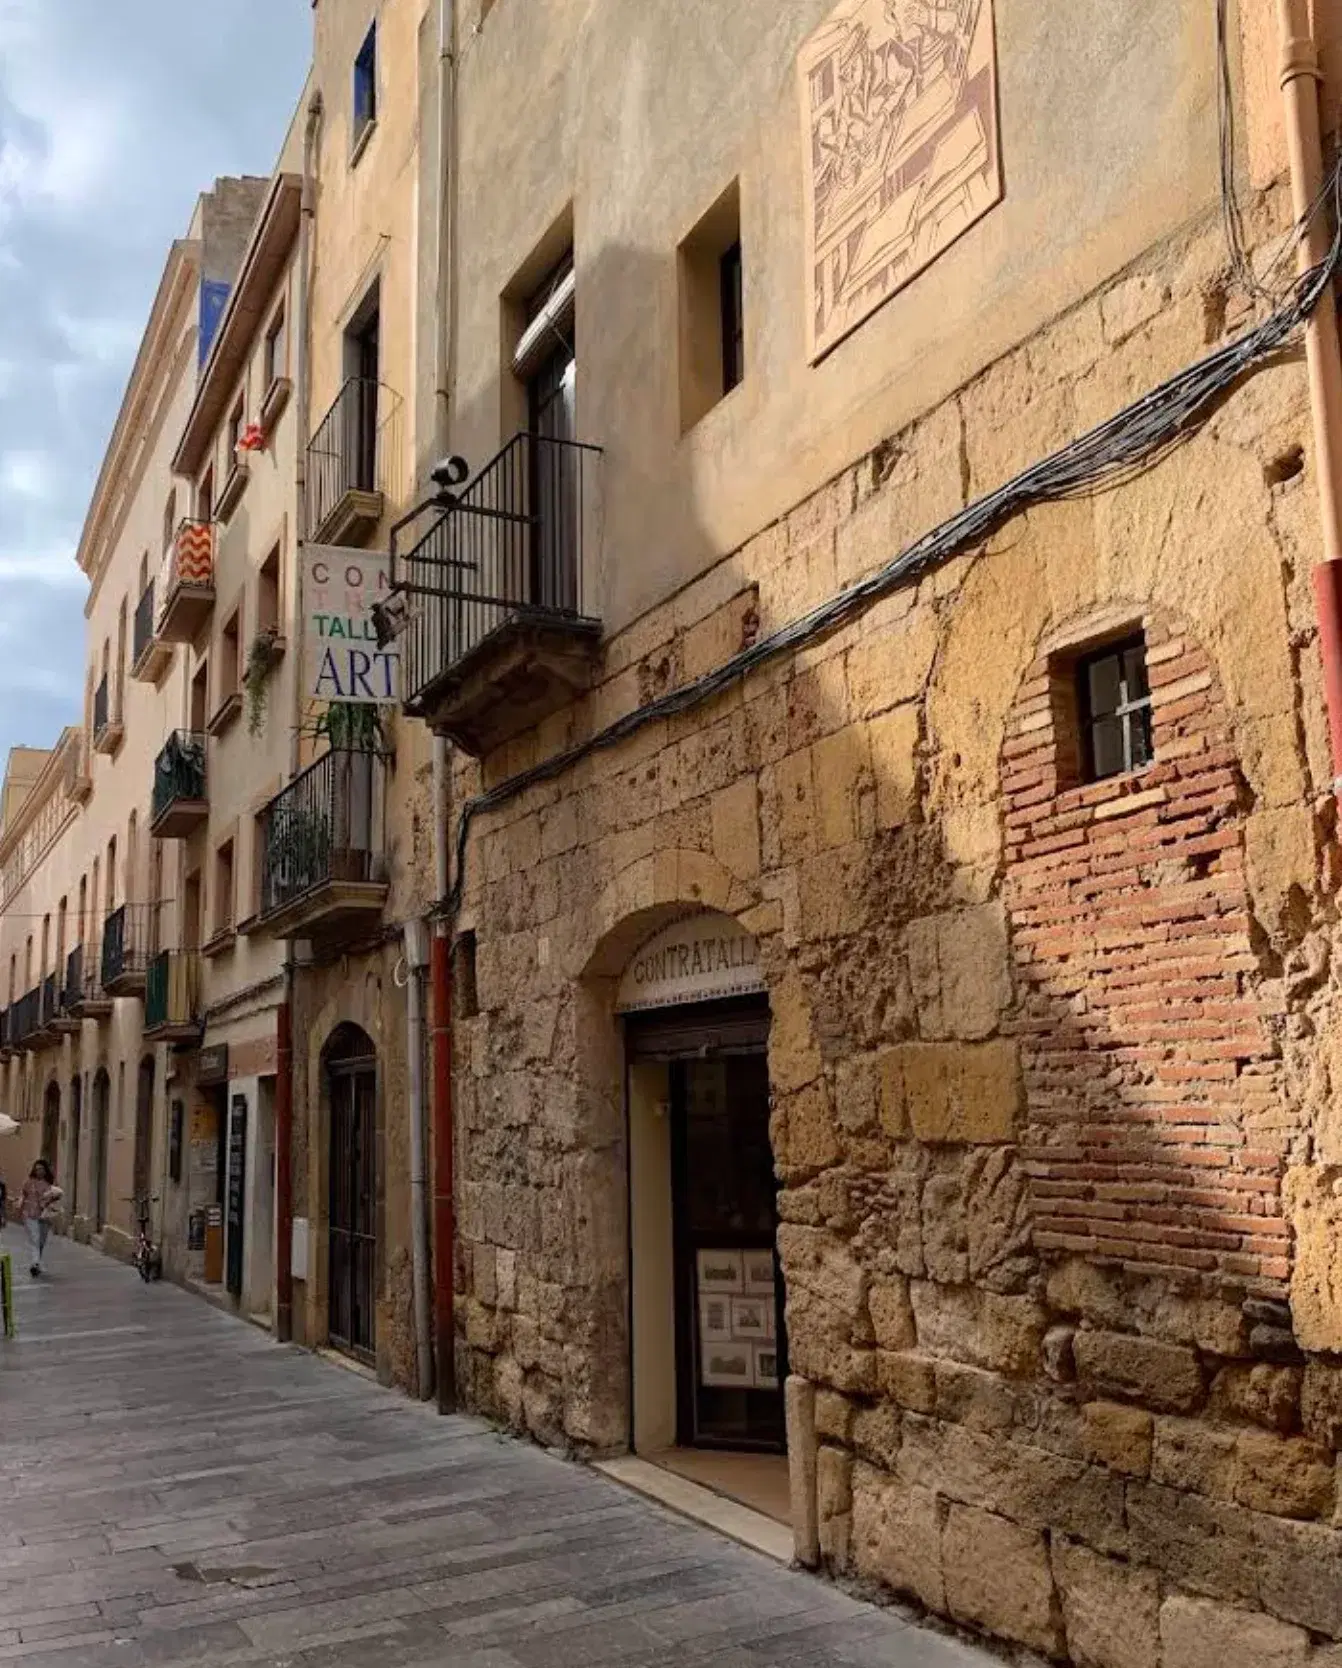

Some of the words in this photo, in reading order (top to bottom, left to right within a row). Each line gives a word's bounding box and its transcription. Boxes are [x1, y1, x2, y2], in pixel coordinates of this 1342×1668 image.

[312, 588, 365, 611] TR
[312, 615, 379, 640] TALL
[313, 647, 400, 699] ART
[634, 934, 757, 984] CONTRATALL
